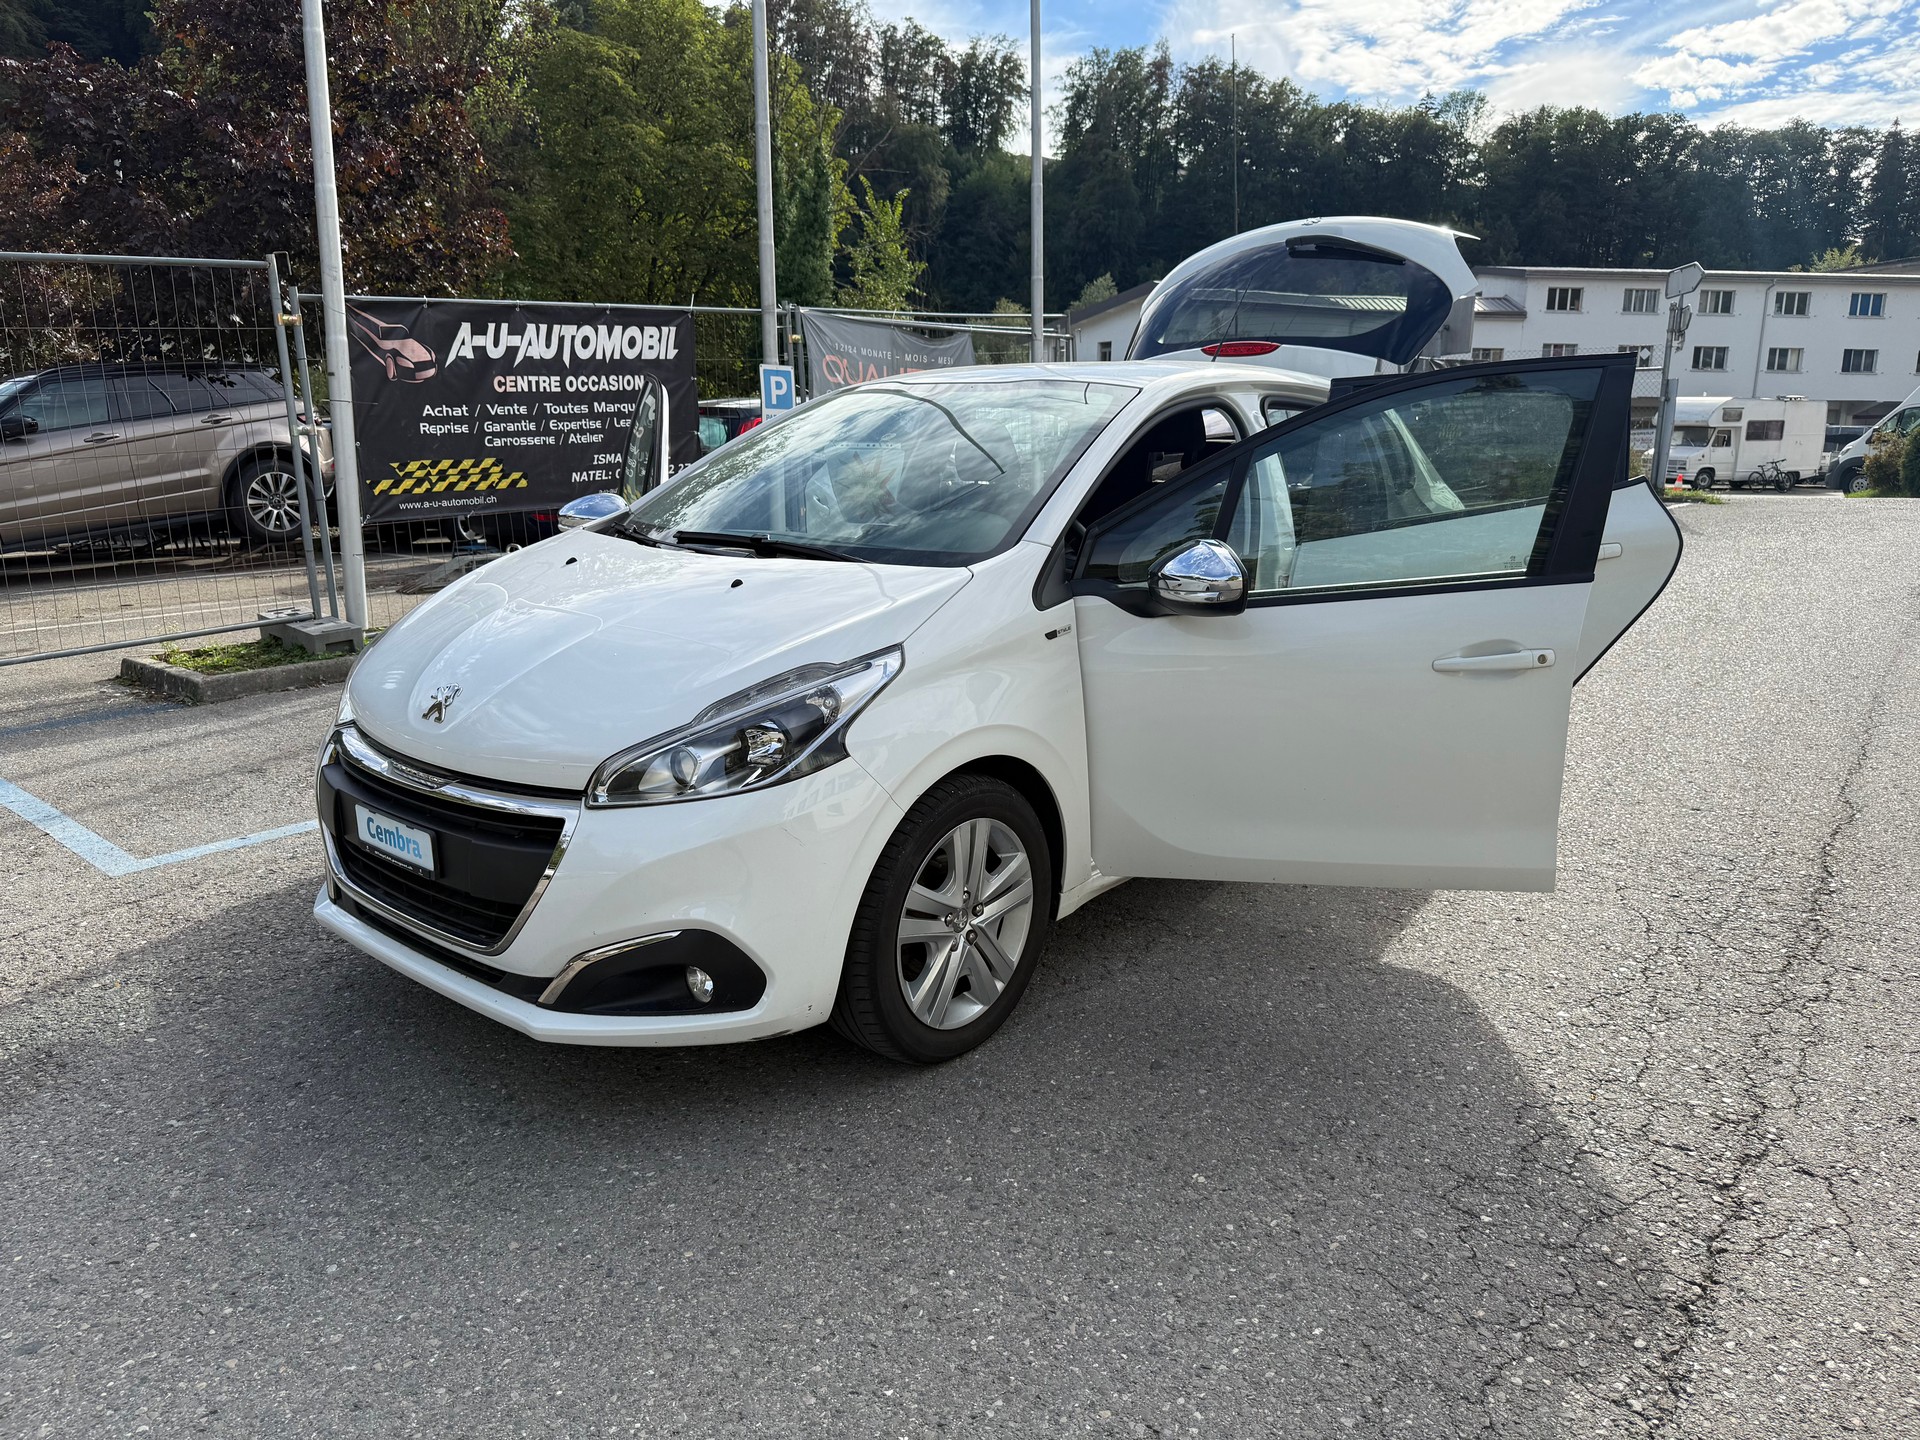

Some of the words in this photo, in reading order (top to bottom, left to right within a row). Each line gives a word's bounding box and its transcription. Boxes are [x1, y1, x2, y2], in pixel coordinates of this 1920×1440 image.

[445, 322, 679, 369] A-U-AUTOMOBIL
[861, 347, 892, 360] MONATE
[905, 353, 928, 363] MOIS
[493, 375, 561, 392] CENTRE
[565, 374, 644, 392] OCCASION
[770, 375, 788, 405] P
[423, 403, 469, 417] Achat
[486, 402, 528, 416] Vente
[544, 402, 589, 415] Toutes
[594, 401, 635, 414] Marqu
[419, 422, 469, 436] Reprise
[484, 420, 536, 433] Garantie
[549, 418, 602, 433] Expertise
[484, 434, 556, 447] Carrosserie
[568, 432, 604, 445] Atelier
[593, 453, 622, 465] ISMA
[572, 470, 612, 483] NATEL:
[399, 495, 497, 510] www.a-u-automobil.ch
[366, 816, 422, 859] Cembra
